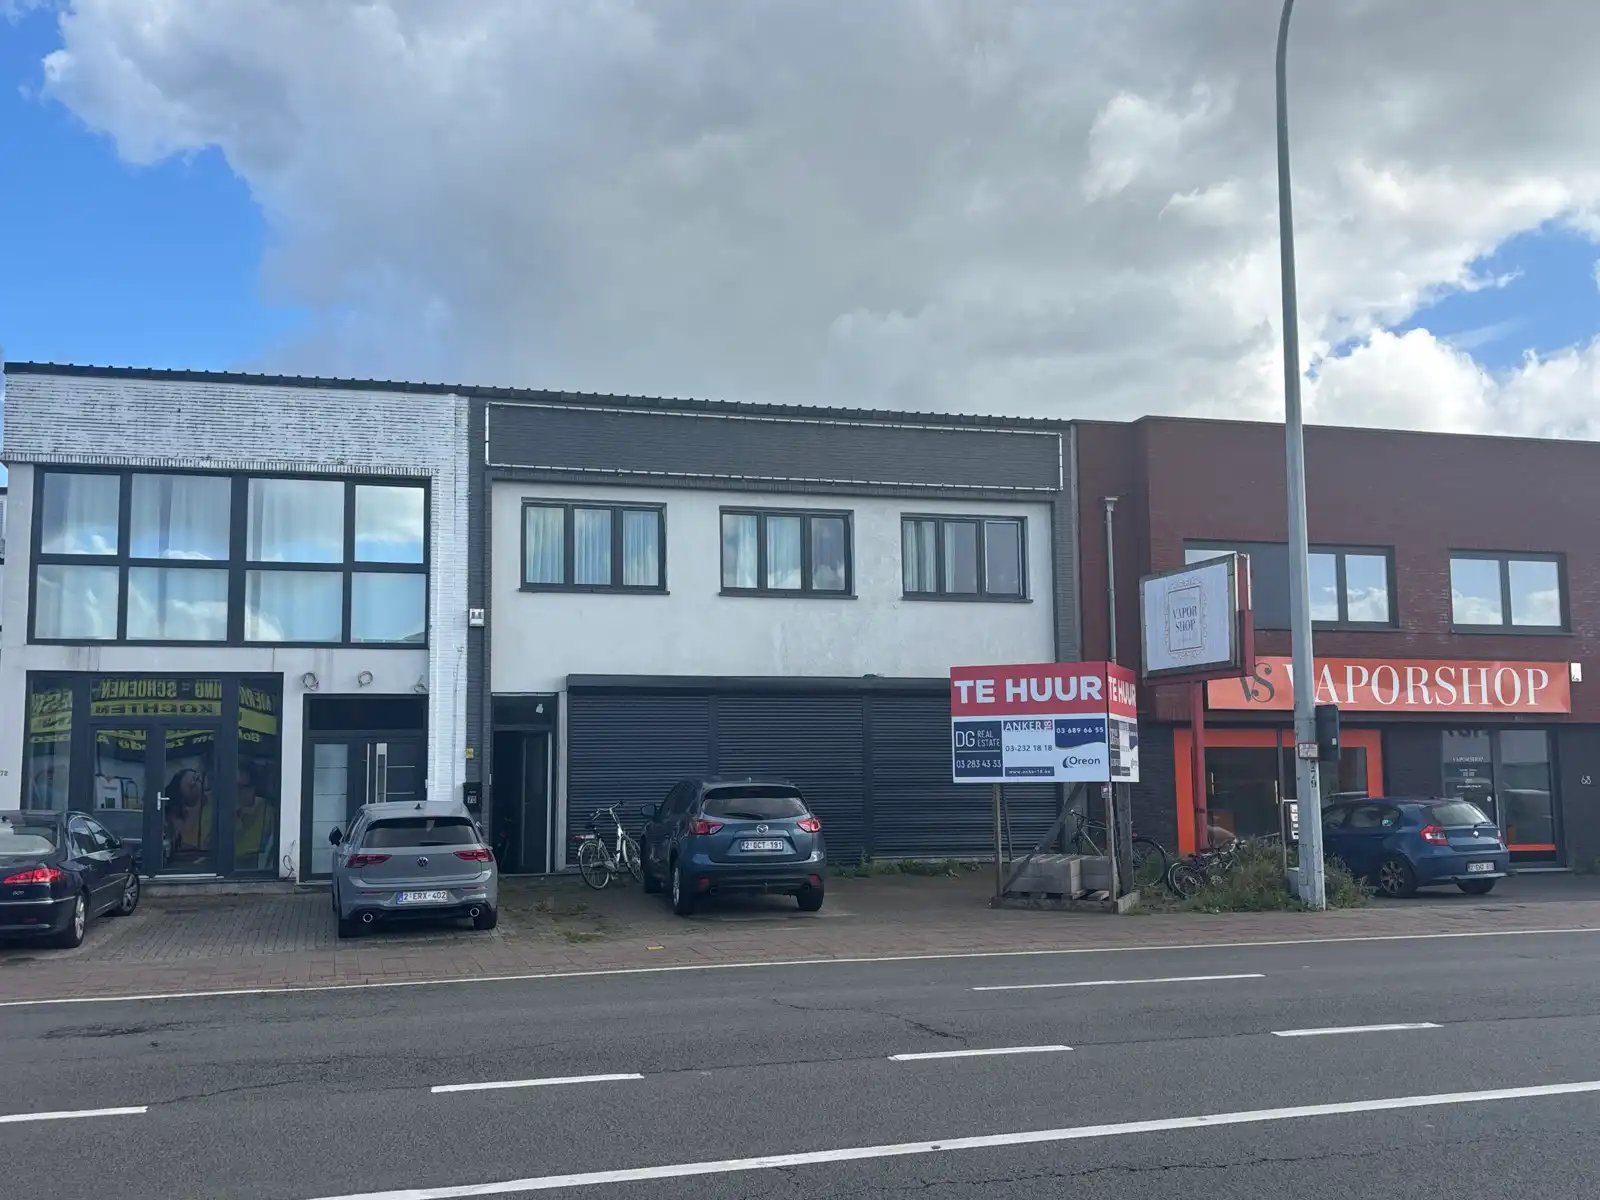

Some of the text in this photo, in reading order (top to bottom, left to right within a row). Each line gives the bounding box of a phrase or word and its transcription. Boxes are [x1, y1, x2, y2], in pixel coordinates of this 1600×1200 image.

[1172, 605, 1197, 619] VAPOR
[1175, 619, 1196, 633] SHOP
[954, 675, 1103, 704] TE HUUR
[1281, 663, 1549, 706] APORSHOP
[1107, 675, 1136, 708] TE HUUR
[1004, 721, 1042, 731] ANKER
[955, 730, 976, 747] DG
[977, 729, 994, 738] REAL
[977, 738, 1001, 747] ESTATE
[1044, 744, 1053, 752] 18
[956, 759, 1002, 769] 03 283 43 33
[1068, 756, 1101, 765] Oreon
[1580, 775, 1592, 785] 68
